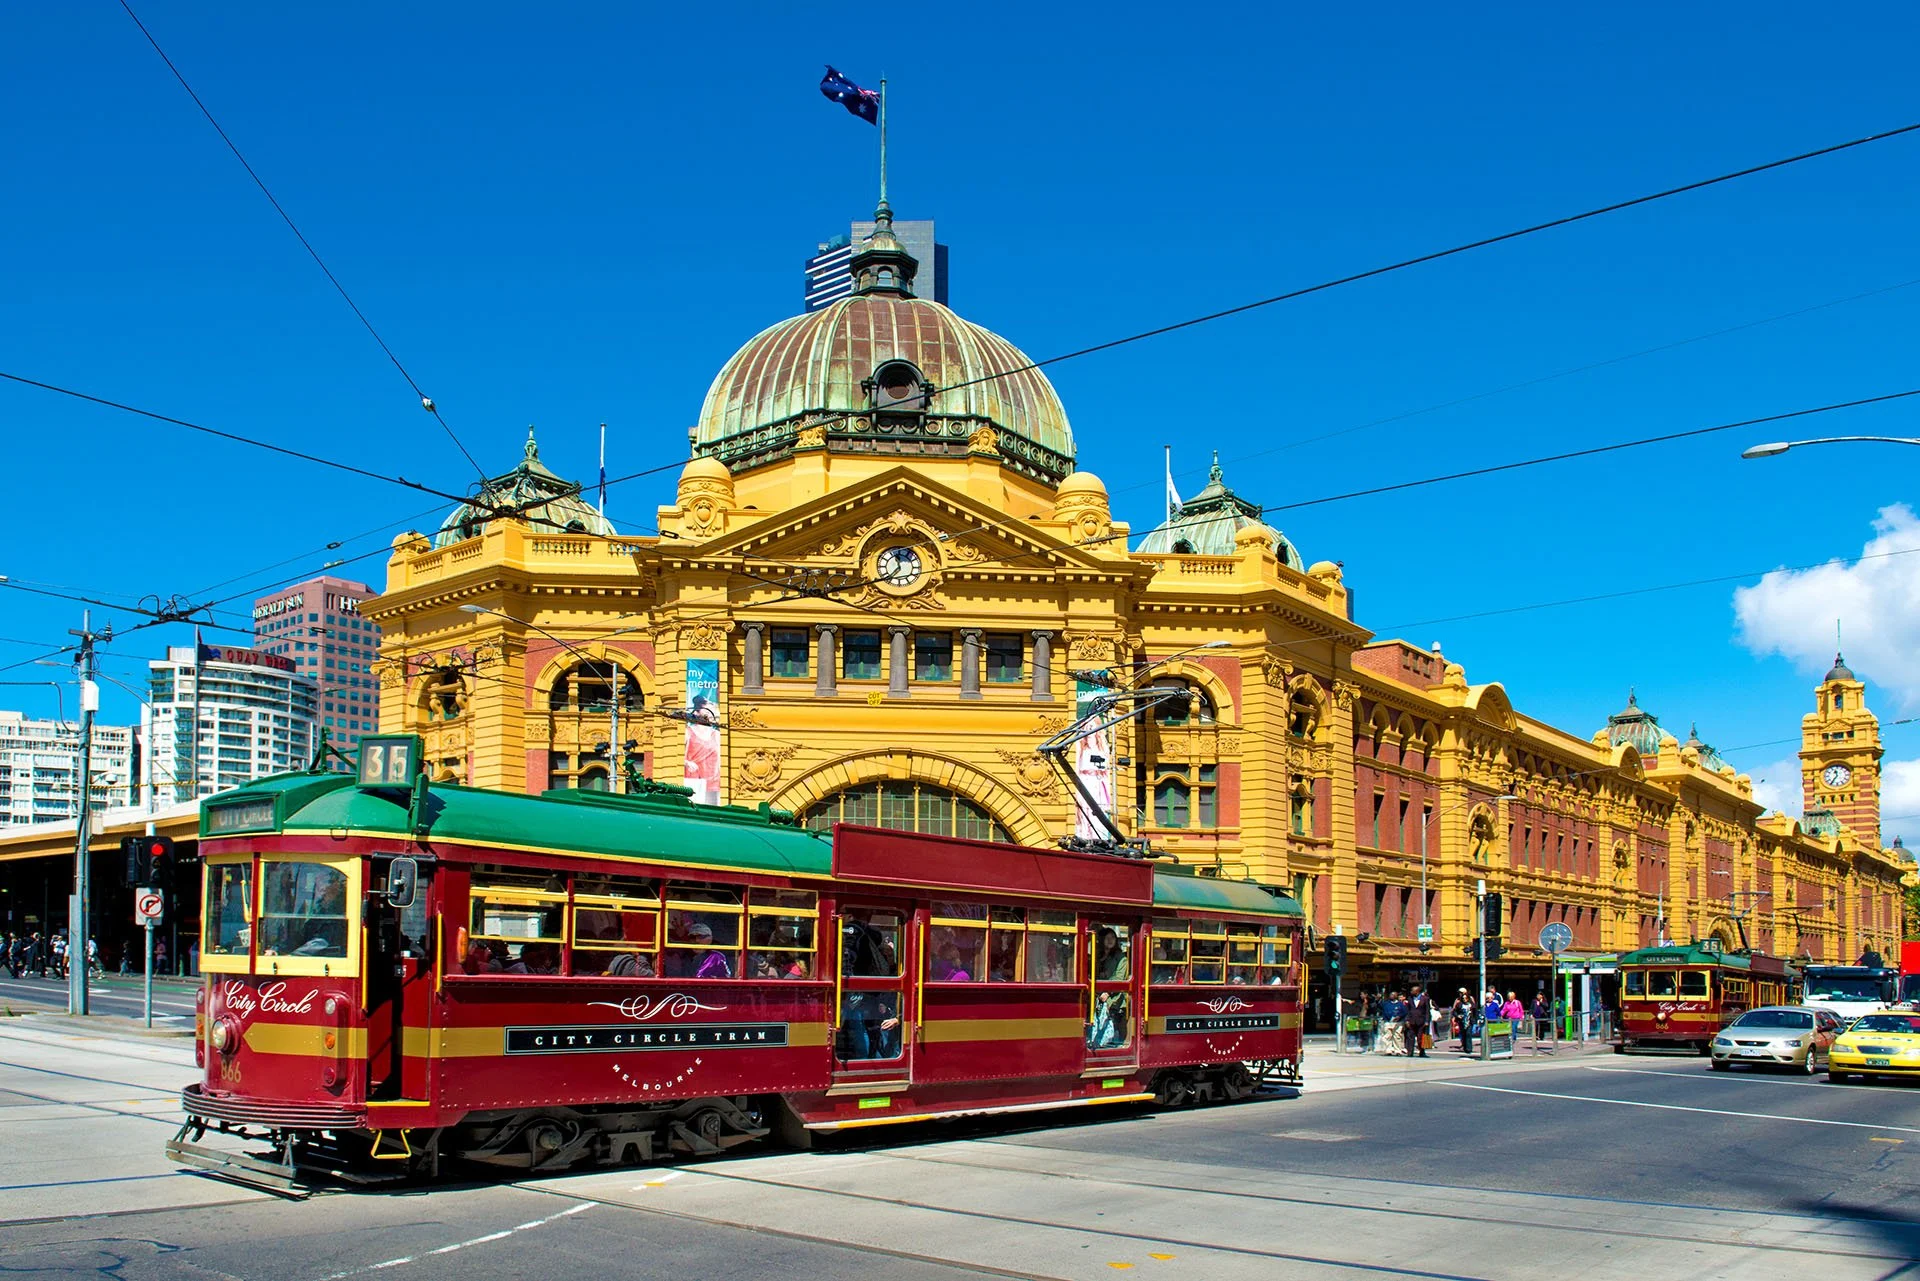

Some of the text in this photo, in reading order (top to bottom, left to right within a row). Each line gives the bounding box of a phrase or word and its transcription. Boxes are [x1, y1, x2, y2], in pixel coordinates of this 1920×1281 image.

[253, 593, 304, 618] HERALD SUN
[226, 649, 259, 664] QUAY
[688, 669, 704, 680] my
[687, 680, 719, 689] metro
[367, 745, 408, 779] 35
[1703, 941, 1718, 950] 35
[224, 979, 319, 1019] City Circle
[1658, 1002, 1699, 1013] City Circle
[1207, 1020, 1241, 1028] CIRCLE
[534, 1031, 766, 1046] CITY CIRCLE TRAM
[220, 1059, 242, 1084] 866
[612, 1057, 702, 1091] MELBOURNE
